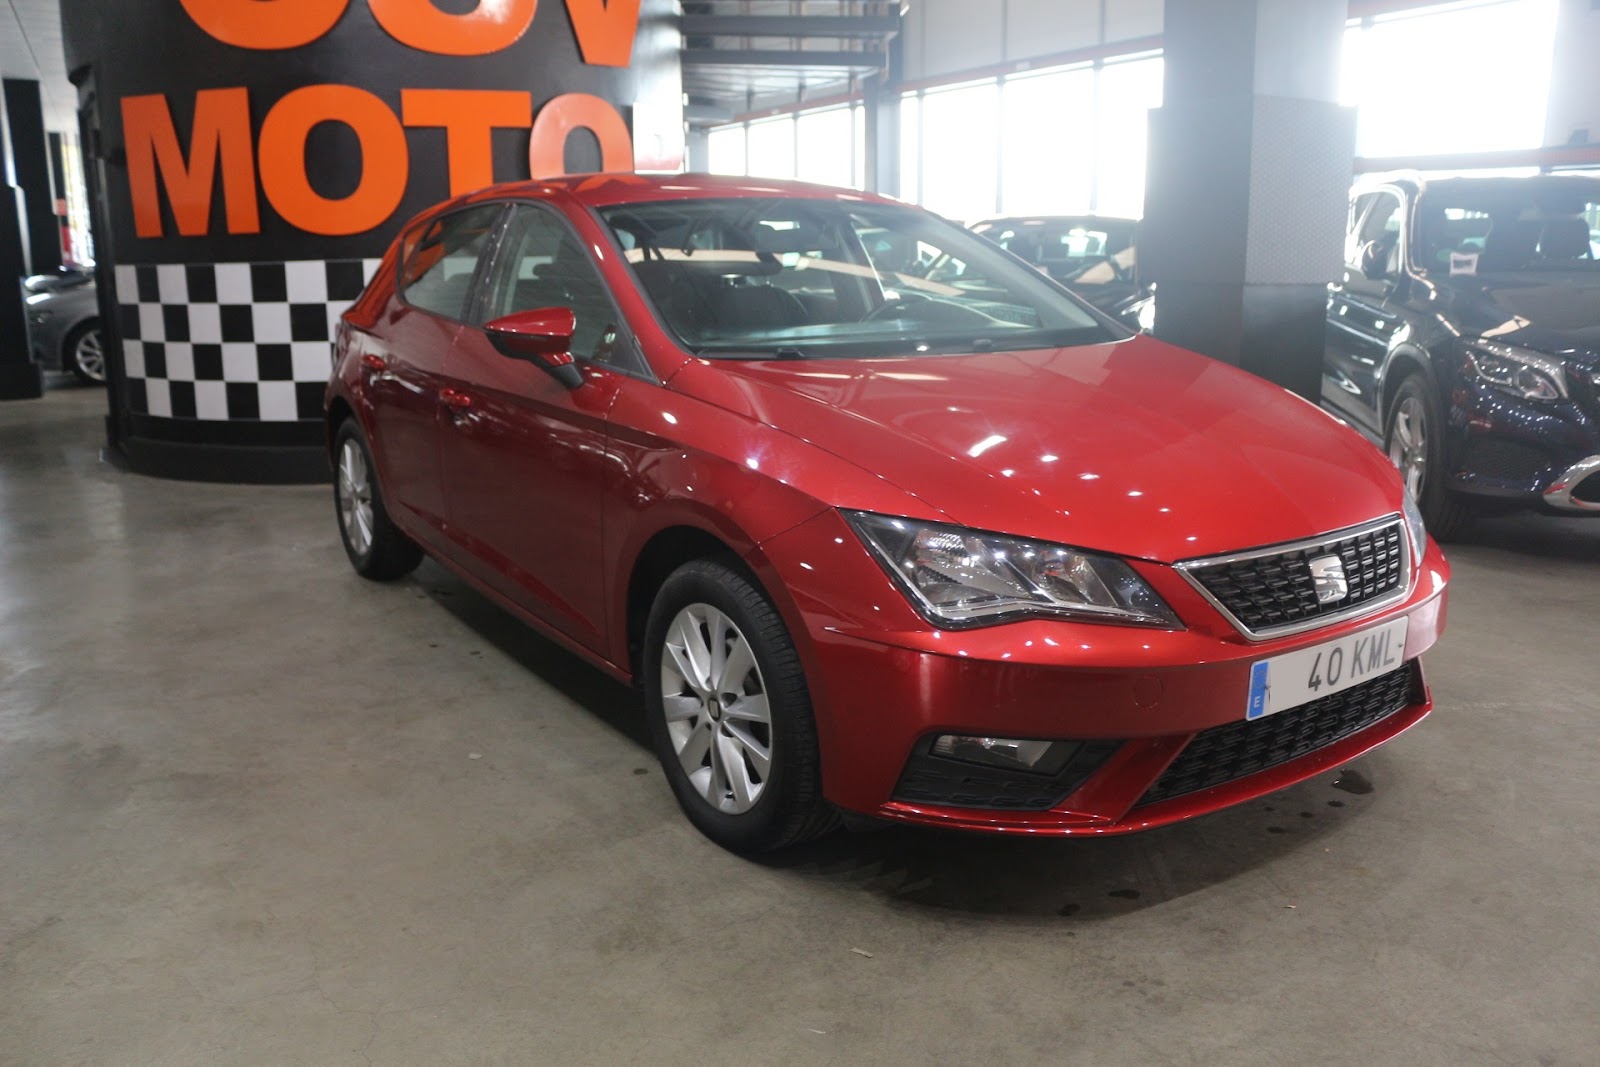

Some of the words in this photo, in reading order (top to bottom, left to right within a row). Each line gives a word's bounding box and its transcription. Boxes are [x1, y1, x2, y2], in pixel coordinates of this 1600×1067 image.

[1307, 647, 1343, 692] 40
[1351, 628, 1395, 678] KML
[1253, 696, 1261, 708] E
